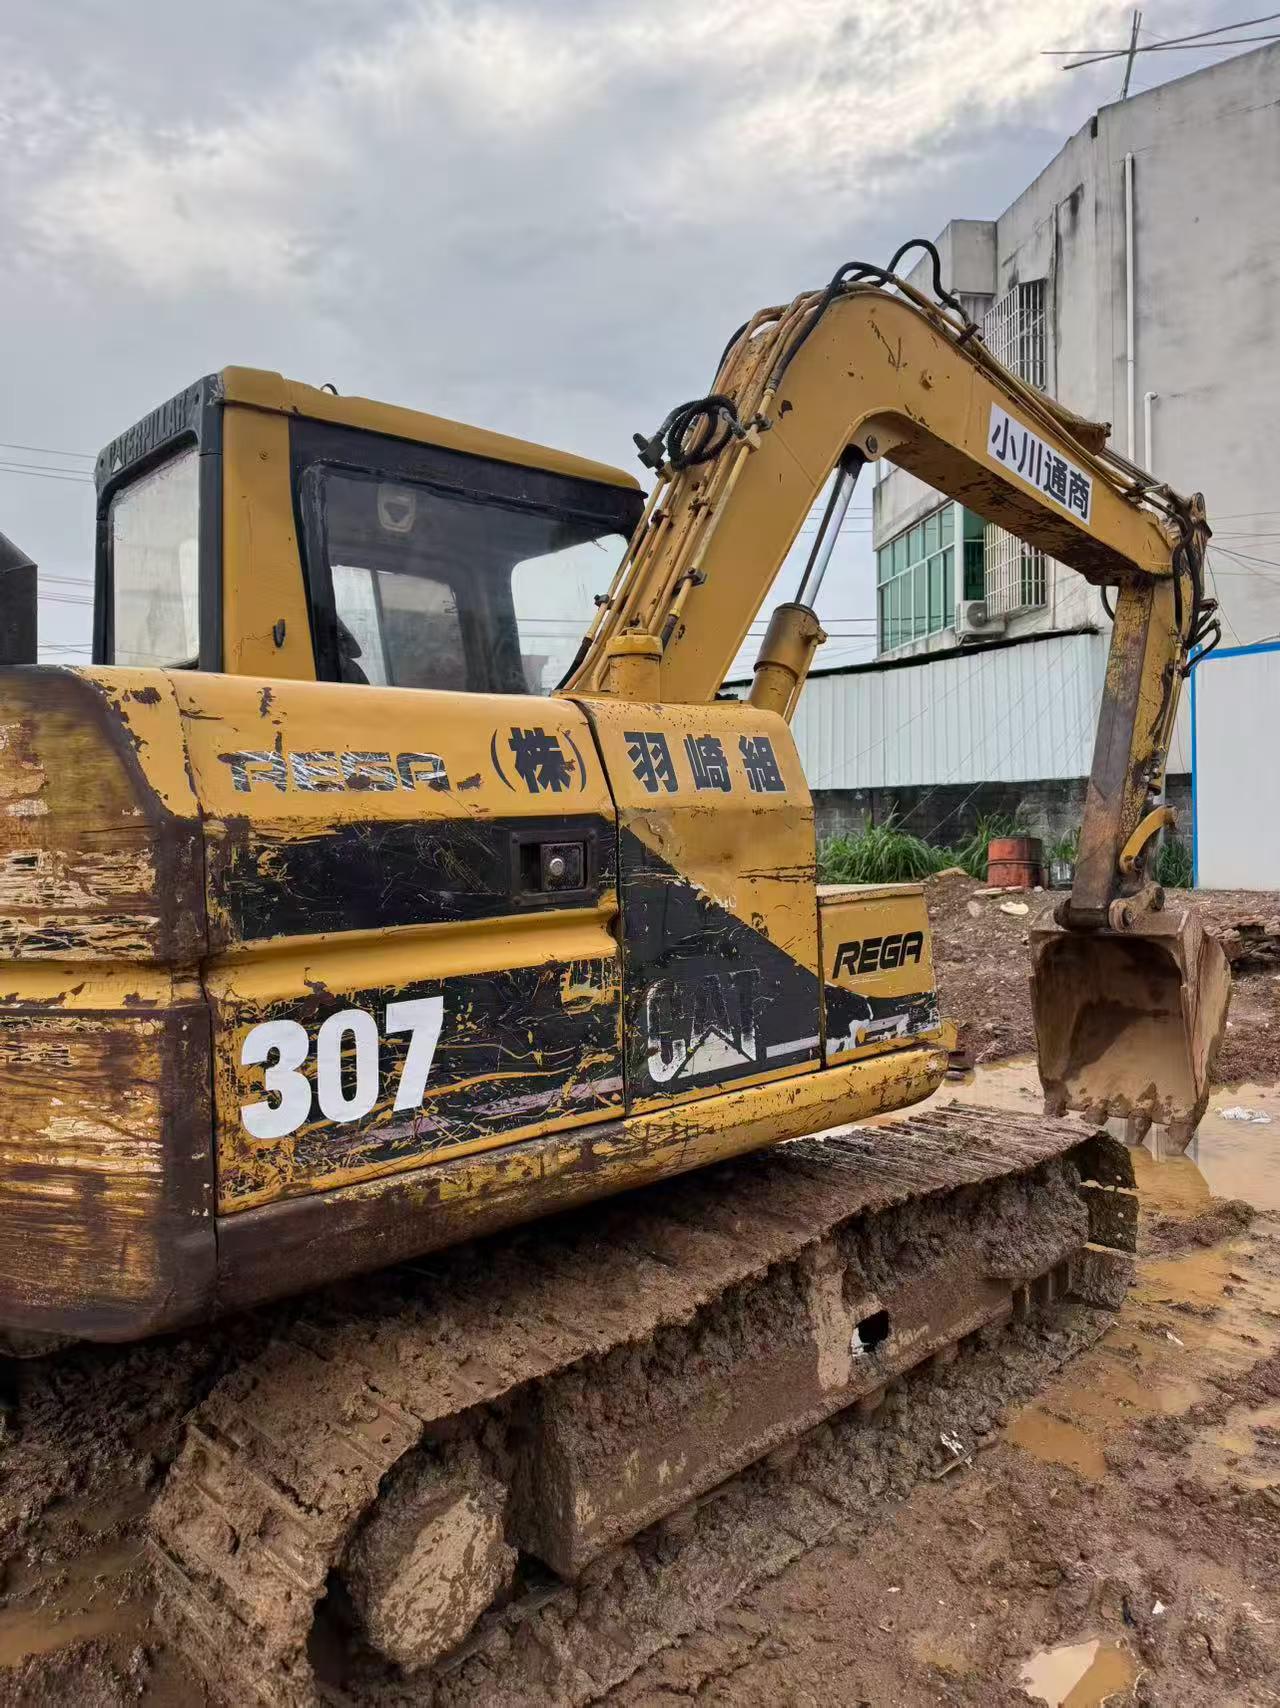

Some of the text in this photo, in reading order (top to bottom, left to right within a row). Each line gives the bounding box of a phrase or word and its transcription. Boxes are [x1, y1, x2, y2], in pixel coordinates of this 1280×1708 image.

[109, 388, 187, 473] CATERPILLAR
[991, 417, 1090, 519] 小川通商
[832, 931, 923, 979] REGA
[241, 996, 443, 1139] 307
